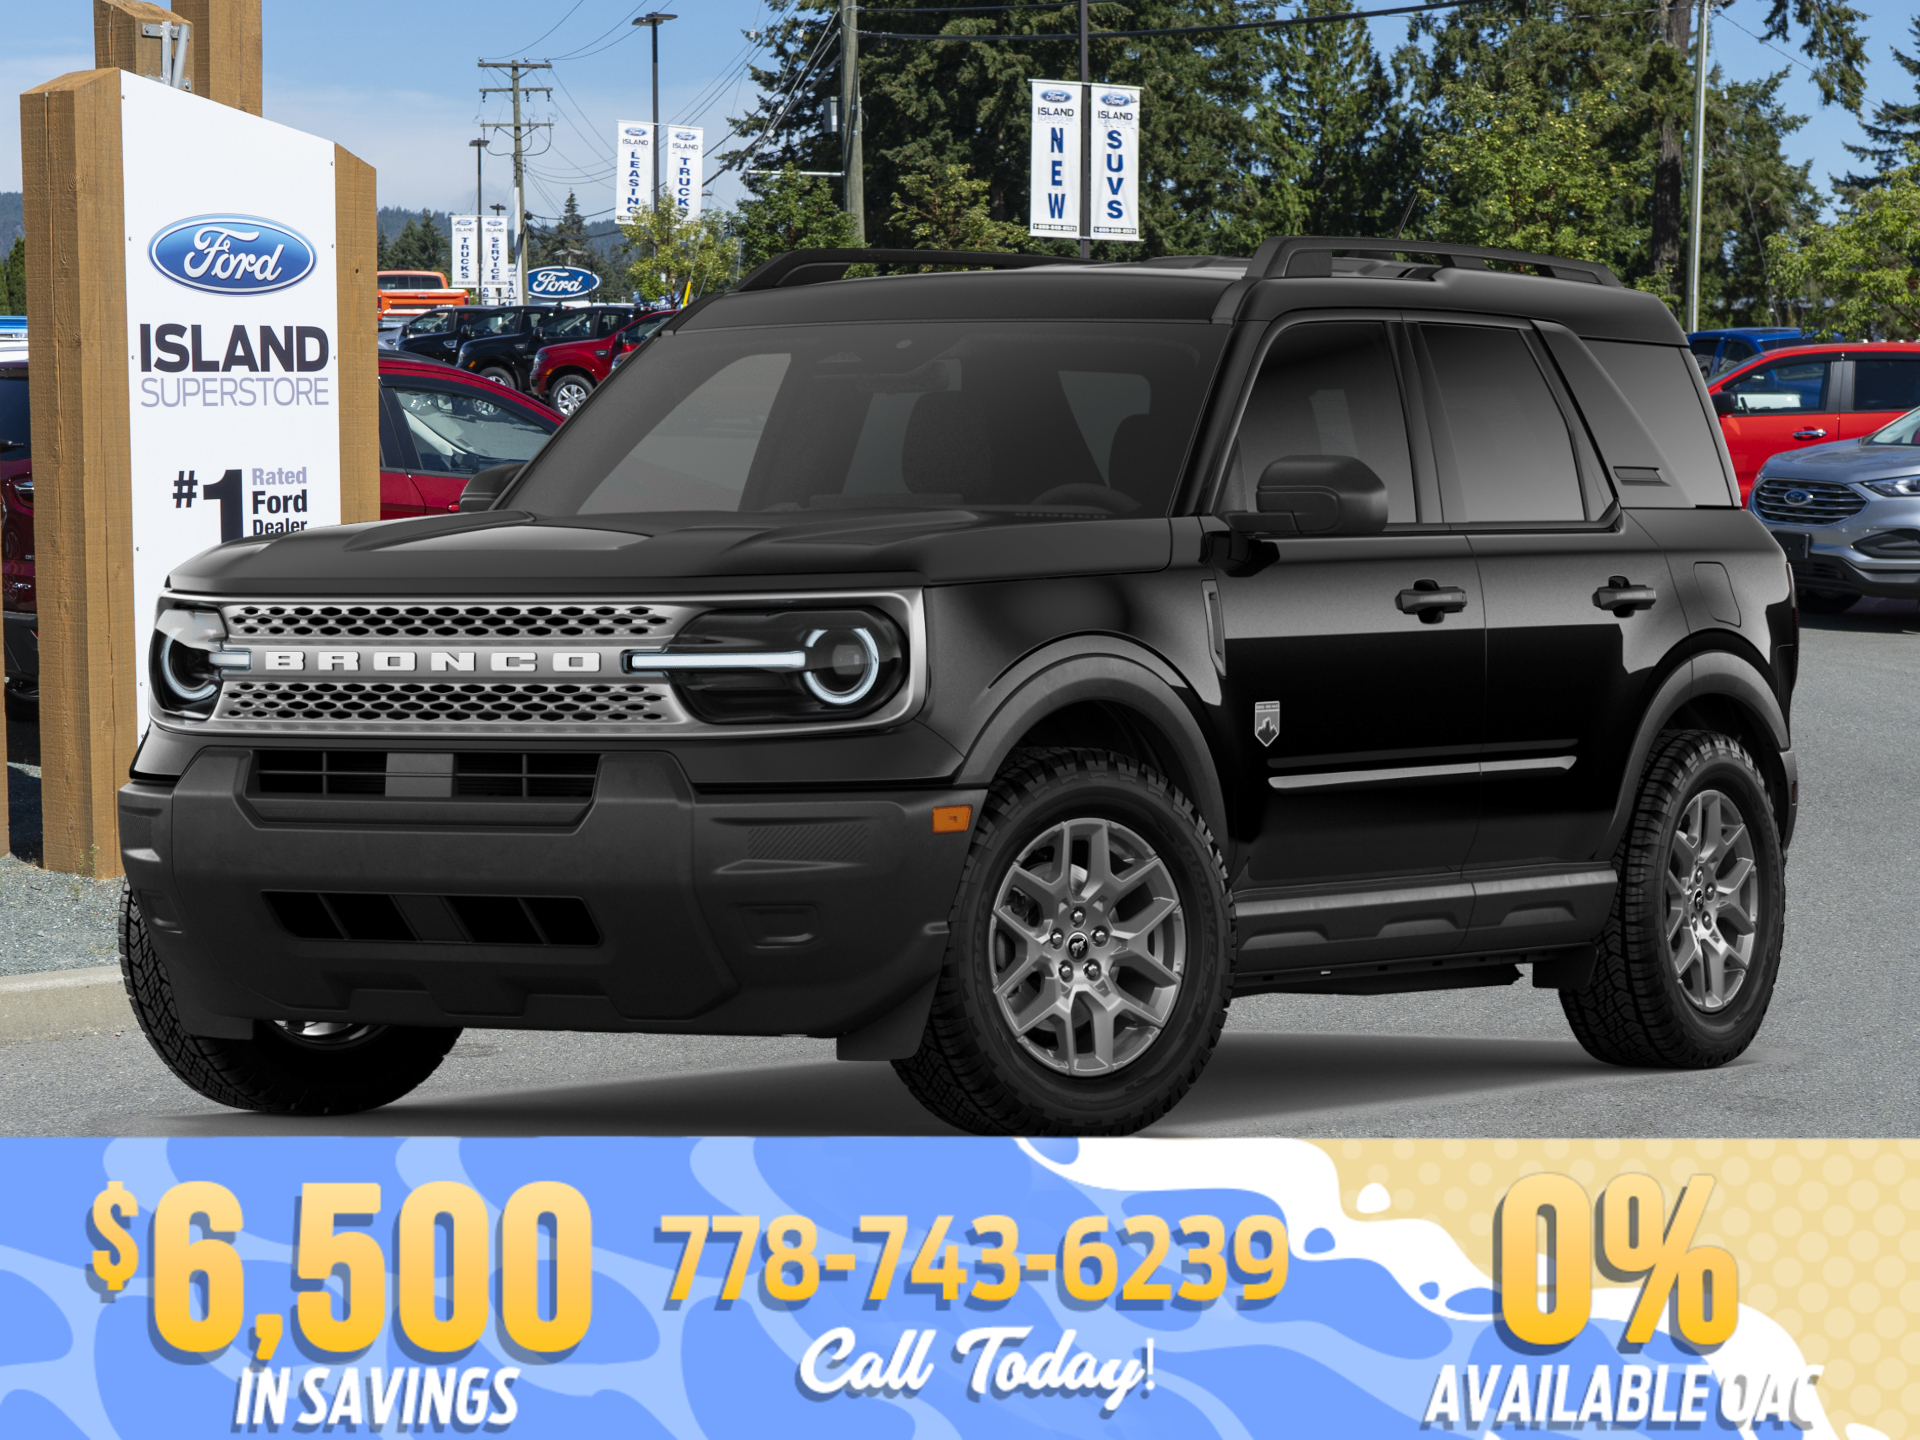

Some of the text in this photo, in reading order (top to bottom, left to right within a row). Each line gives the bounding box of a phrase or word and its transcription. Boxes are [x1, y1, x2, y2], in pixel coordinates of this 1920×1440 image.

[1045, 91, 1067, 101] Ford
[1105, 95, 1126, 105] Ford
[1037, 107, 1074, 117] ISLAND
[1098, 111, 1133, 120] ISLAND
[1048, 127, 1066, 219] NEW
[1106, 130, 1124, 219] SUVS
[184, 226, 285, 281] Ford
[461, 237, 470, 279] TRUCKS
[491, 236, 500, 280] SERVICE
[532, 271, 584, 292] Ford
[140, 323, 329, 373] ISLAND
[140, 377, 329, 408] SUPERSTORE
[252, 467, 307, 485] Rated
[172, 469, 244, 544] #1
[252, 489, 307, 514] Ford
[252, 518, 307, 536] Dealer
[265, 651, 601, 673] BRONCO
[1177, 844, 1217, 976] PROXES
